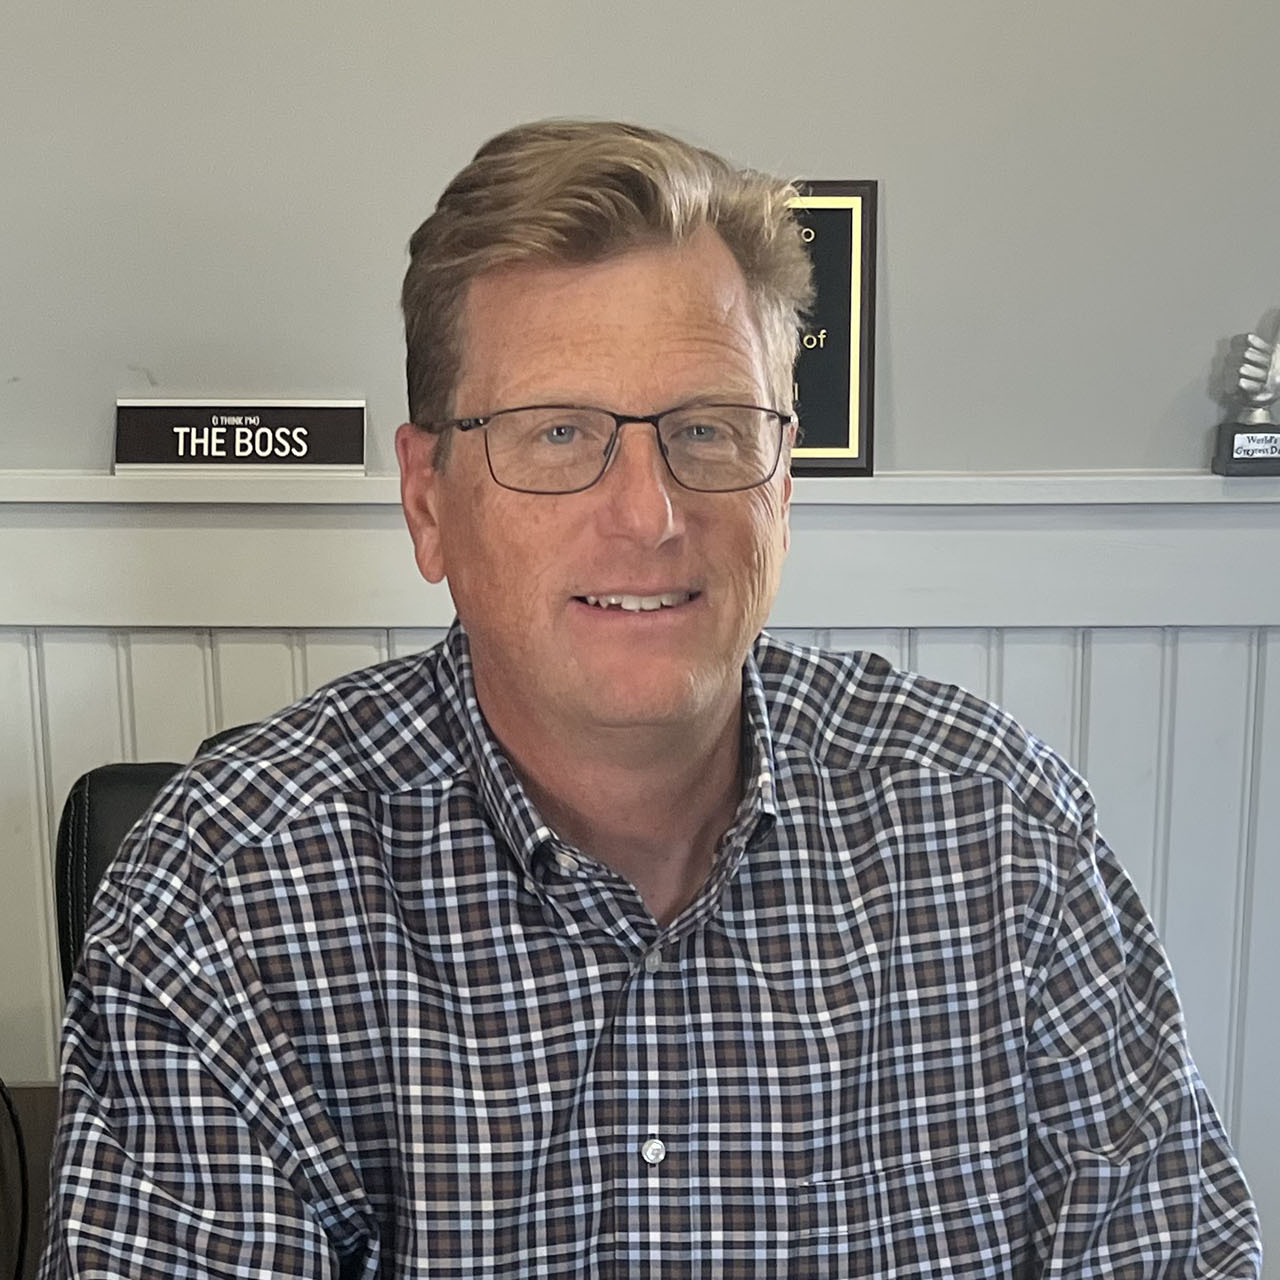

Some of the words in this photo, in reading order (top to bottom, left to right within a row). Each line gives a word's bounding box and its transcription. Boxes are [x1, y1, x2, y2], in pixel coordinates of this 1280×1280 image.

[803, 330, 827, 349] of
[220, 416, 243, 425] THINK
[173, 427, 226, 456] THE
[235, 427, 307, 456] BOSS
